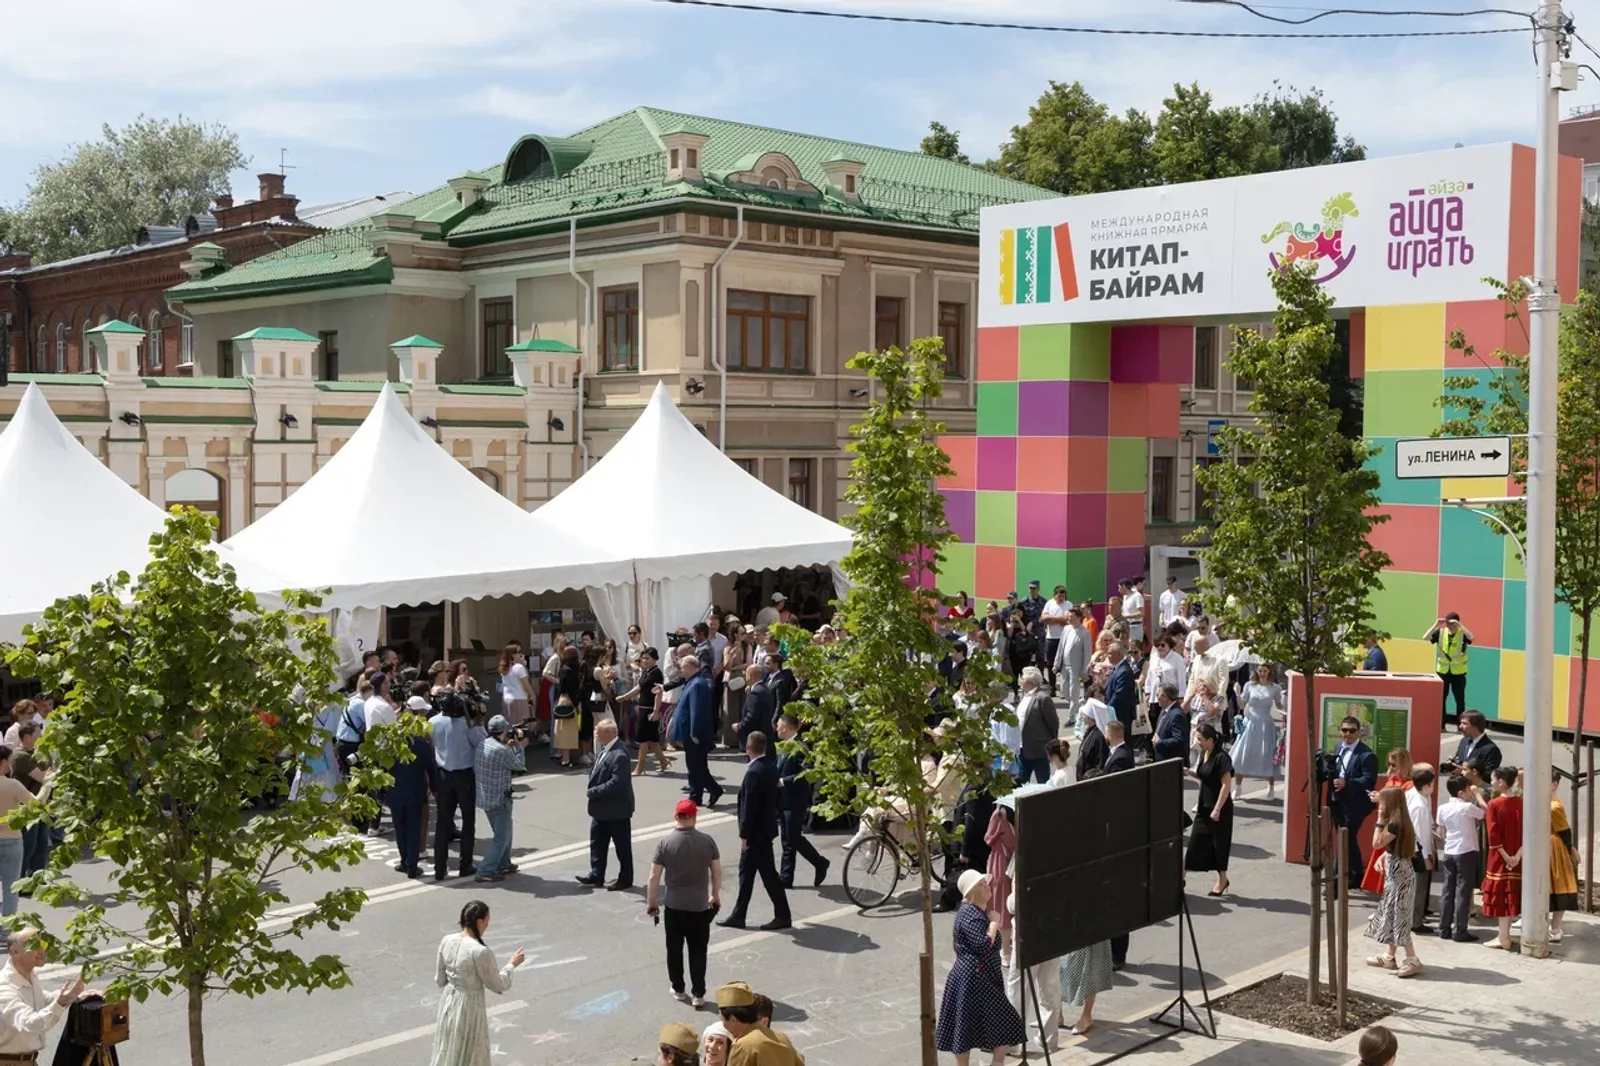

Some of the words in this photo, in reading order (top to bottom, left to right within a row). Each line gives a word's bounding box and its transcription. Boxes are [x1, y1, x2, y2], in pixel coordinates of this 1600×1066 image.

[1090, 208, 1209, 229] МЕЖДУНАРОДНАЯ
[1090, 227, 1148, 242] КНИЖНАЯ
[1150, 221, 1209, 236] ЯРМАРКА
[1090, 241, 1189, 270] КИТАП-
[1387, 235, 1475, 278] играть
[1089, 270, 1204, 301] БАЙРАМ
